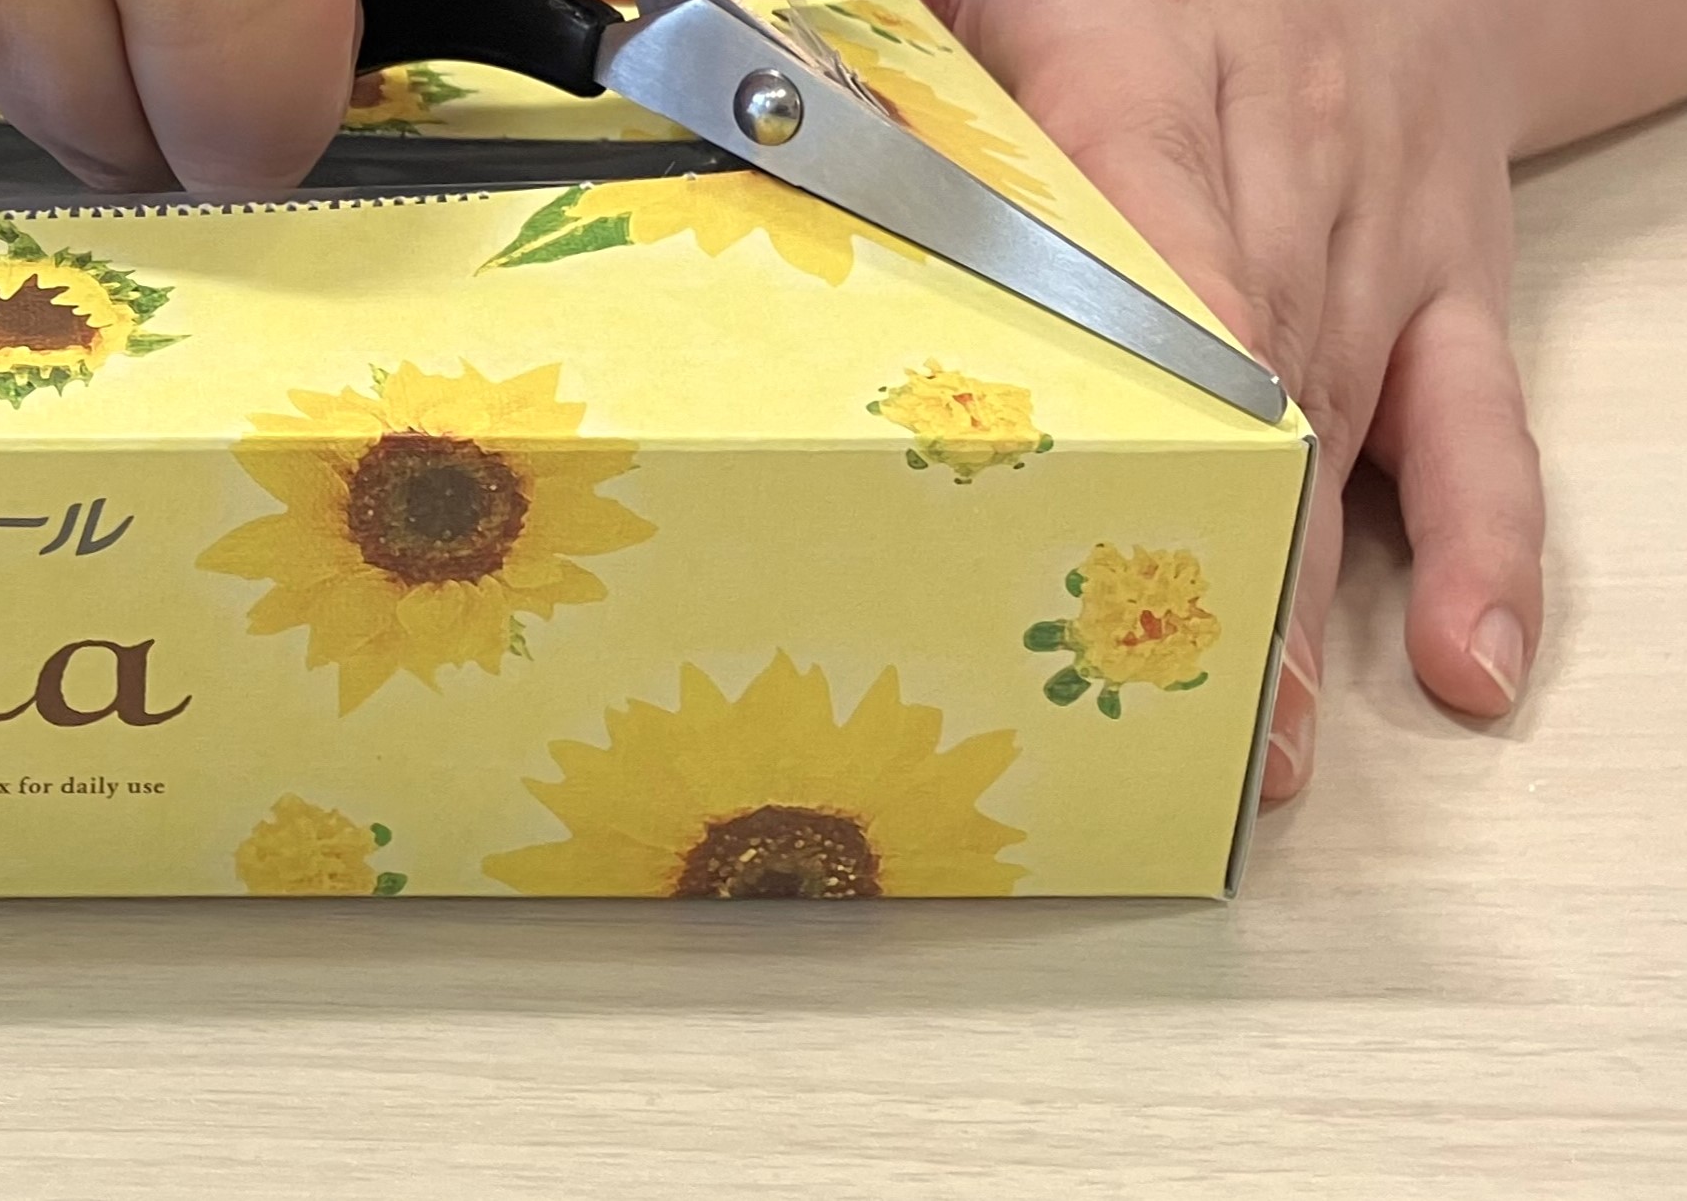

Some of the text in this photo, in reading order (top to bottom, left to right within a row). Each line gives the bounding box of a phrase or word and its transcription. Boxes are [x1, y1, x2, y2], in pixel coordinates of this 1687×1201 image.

[18, 775, 54, 796] for
[60, 776, 119, 800] daily
[127, 782, 165, 795] use
